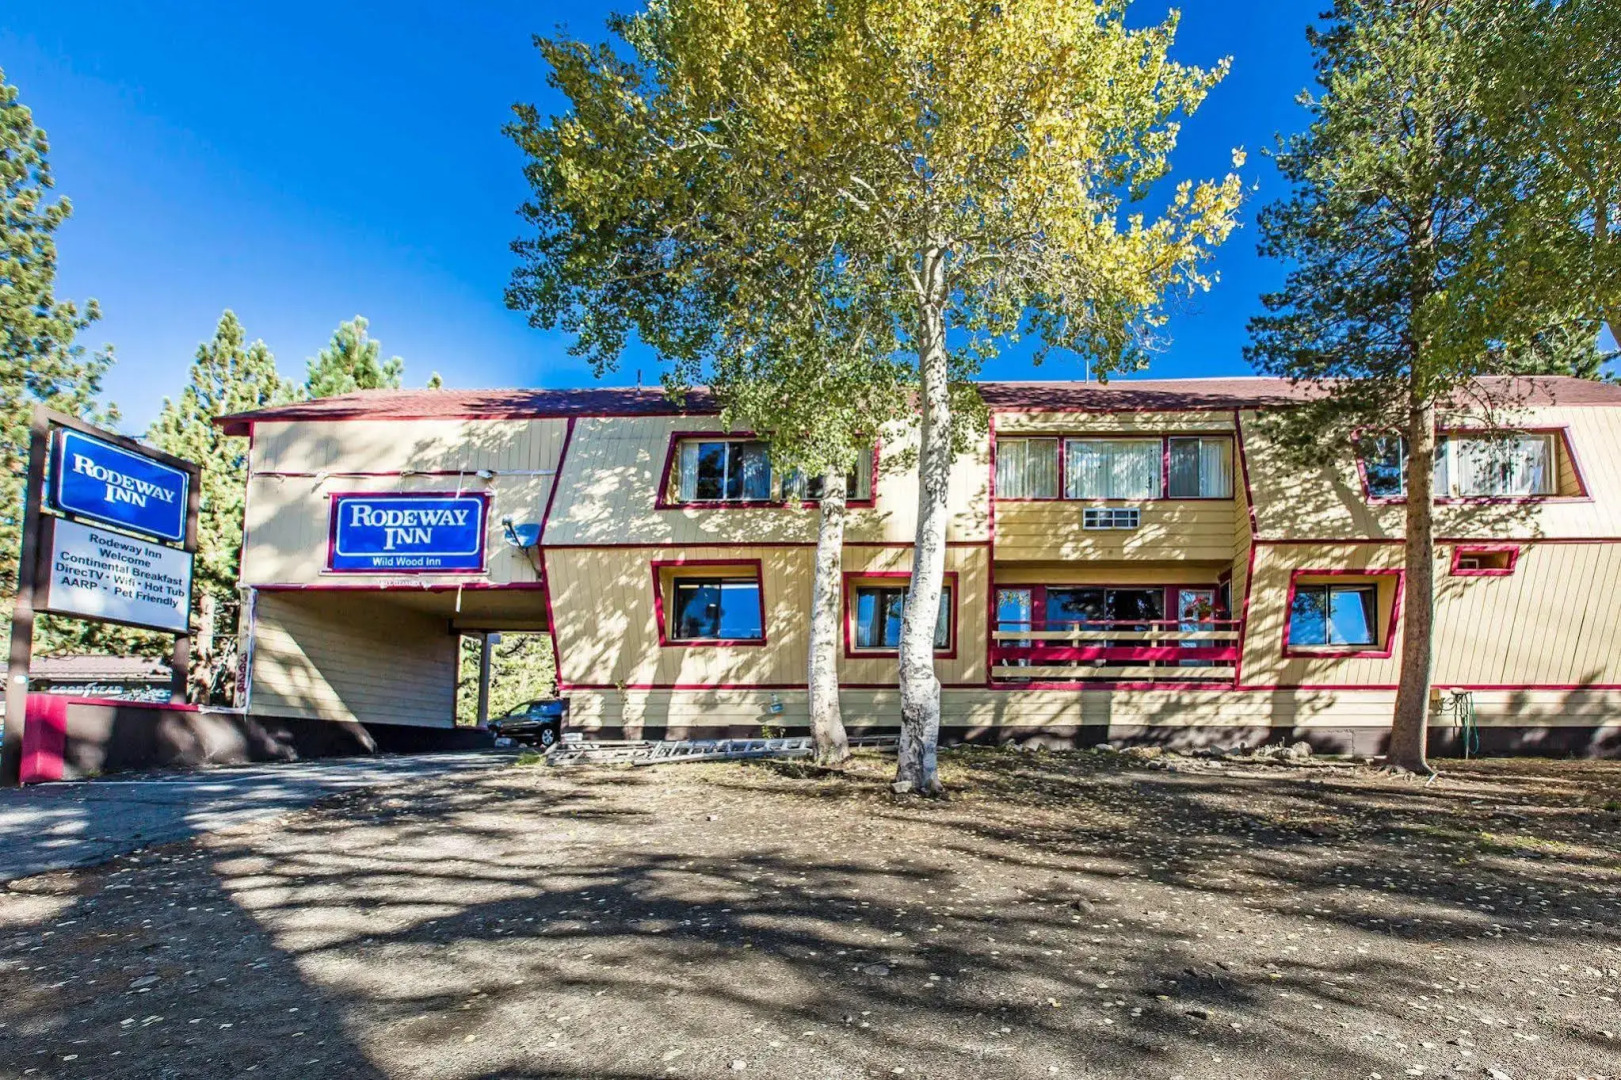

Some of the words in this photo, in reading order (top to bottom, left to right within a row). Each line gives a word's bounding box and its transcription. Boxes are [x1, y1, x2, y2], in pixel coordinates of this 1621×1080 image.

[73, 453, 175, 503] RODEWAY
[104, 483, 147, 508] INN
[350, 504, 469, 527] RODEWAY
[89, 533, 142, 556] Rodeway
[145, 547, 162, 559] Inn
[383, 527, 432, 550] INN
[60, 551, 129, 574] Continental
[132, 567, 182, 586] Breakfast
[99, 547, 151, 568] Welcome
[372, 556, 394, 566] Wild
[395, 556, 424, 566] Wood
[425, 557, 441, 566] Inn
[60, 576, 98, 590] AARP
[114, 586, 133, 599] Pet
[136, 589, 179, 608] Friendly
[144, 581, 163, 593] Hot
[166, 586, 185, 598] Tub
